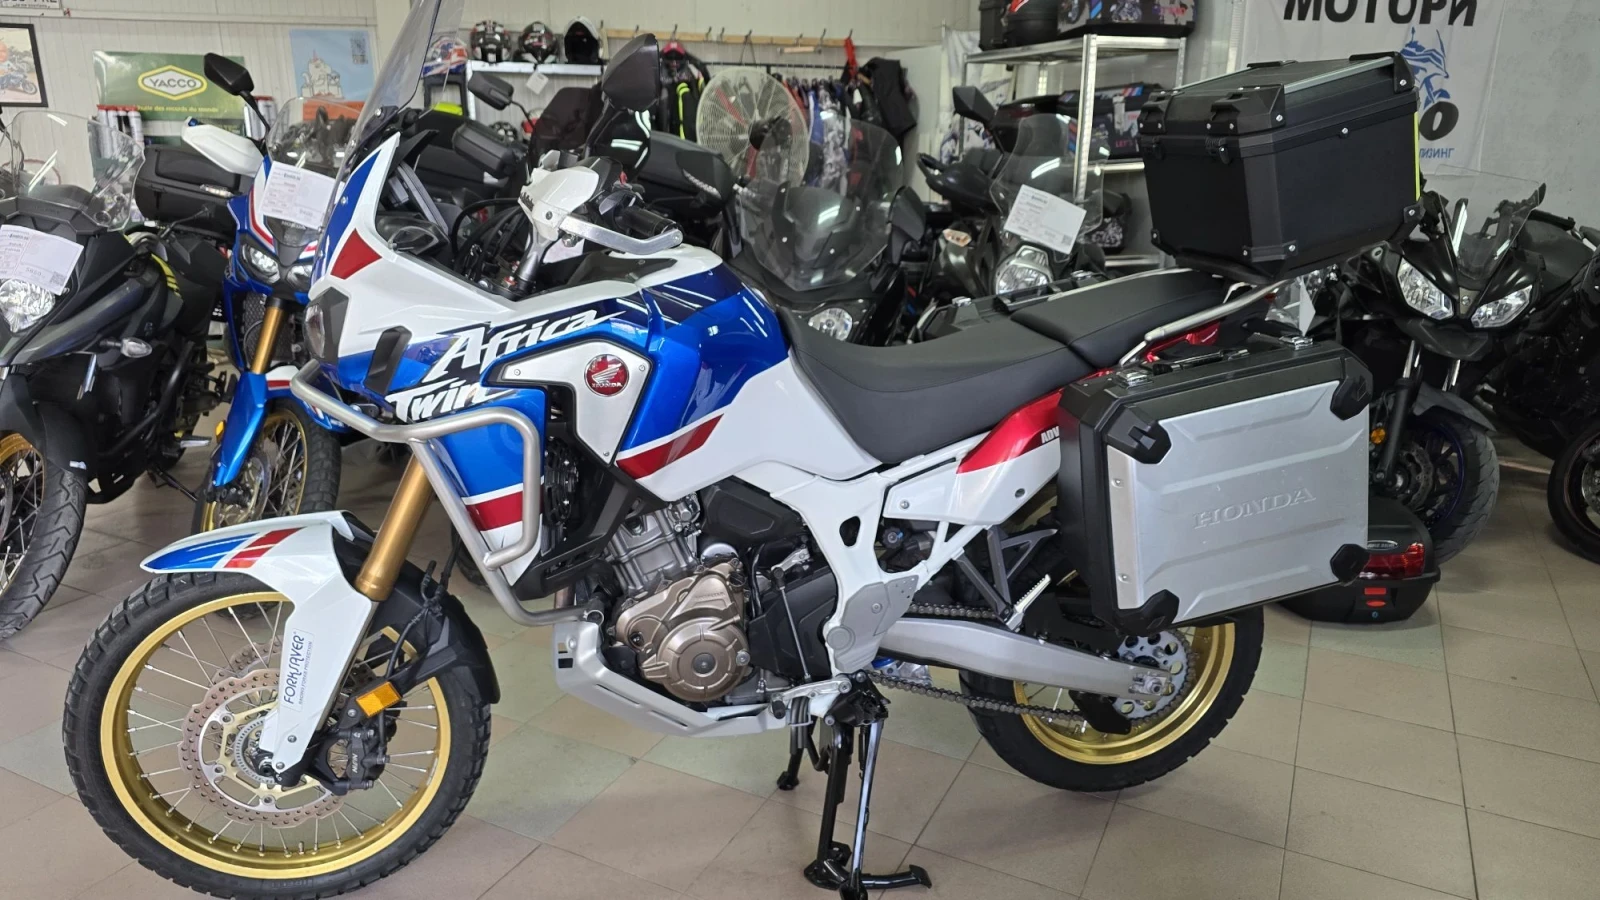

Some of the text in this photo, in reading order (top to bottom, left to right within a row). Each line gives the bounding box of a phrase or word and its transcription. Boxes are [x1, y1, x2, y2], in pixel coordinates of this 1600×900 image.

[150, 78, 197, 88] YACCO
[421, 309, 627, 383] Africa
[384, 377, 518, 422] Twin
[1193, 487, 1317, 529] HONDA
[284, 634, 304, 704] FORKSAVER
